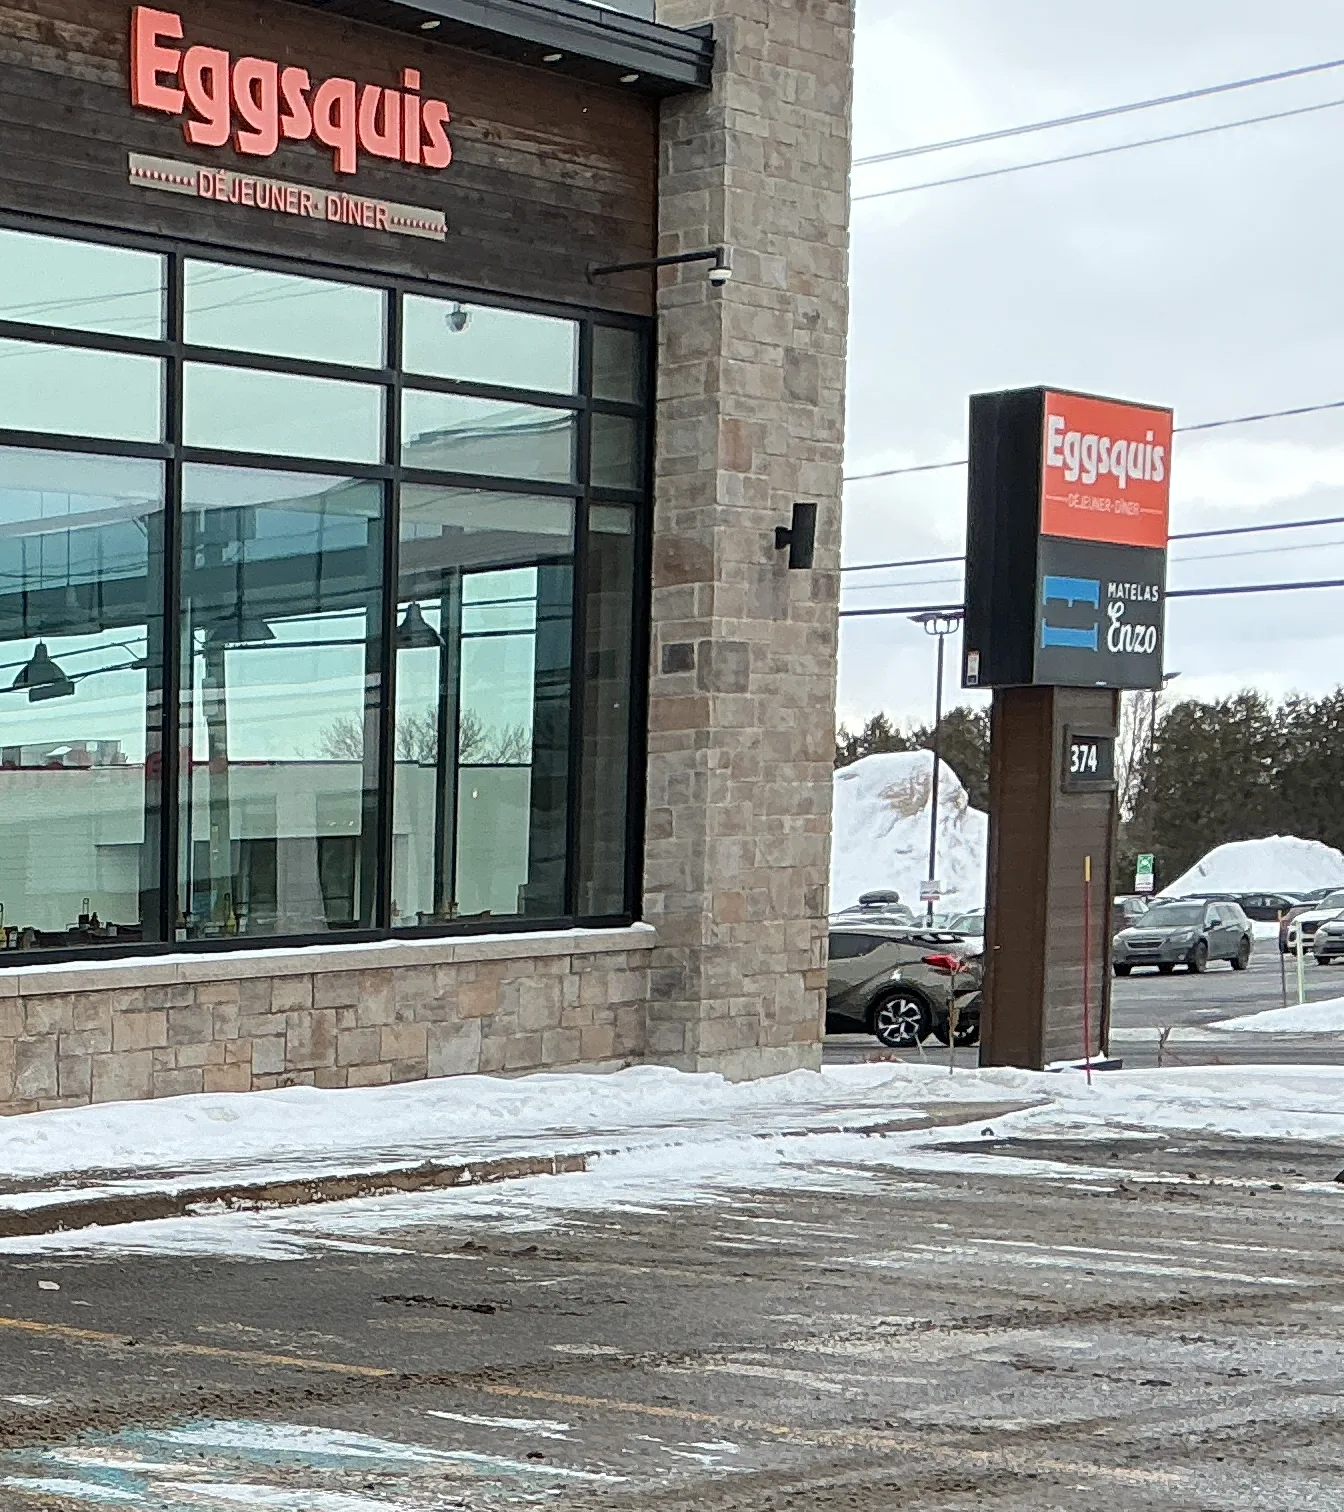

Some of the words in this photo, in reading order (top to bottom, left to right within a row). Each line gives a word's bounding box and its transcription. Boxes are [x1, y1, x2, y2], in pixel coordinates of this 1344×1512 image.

[130, 6, 452, 174] Eggsquis
[1047, 414, 1164, 489] Eggsquis
[1108, 582, 1159, 602] MATELAS
[1107, 601, 1157, 653] Enzo
[1070, 744, 1098, 773] 374
